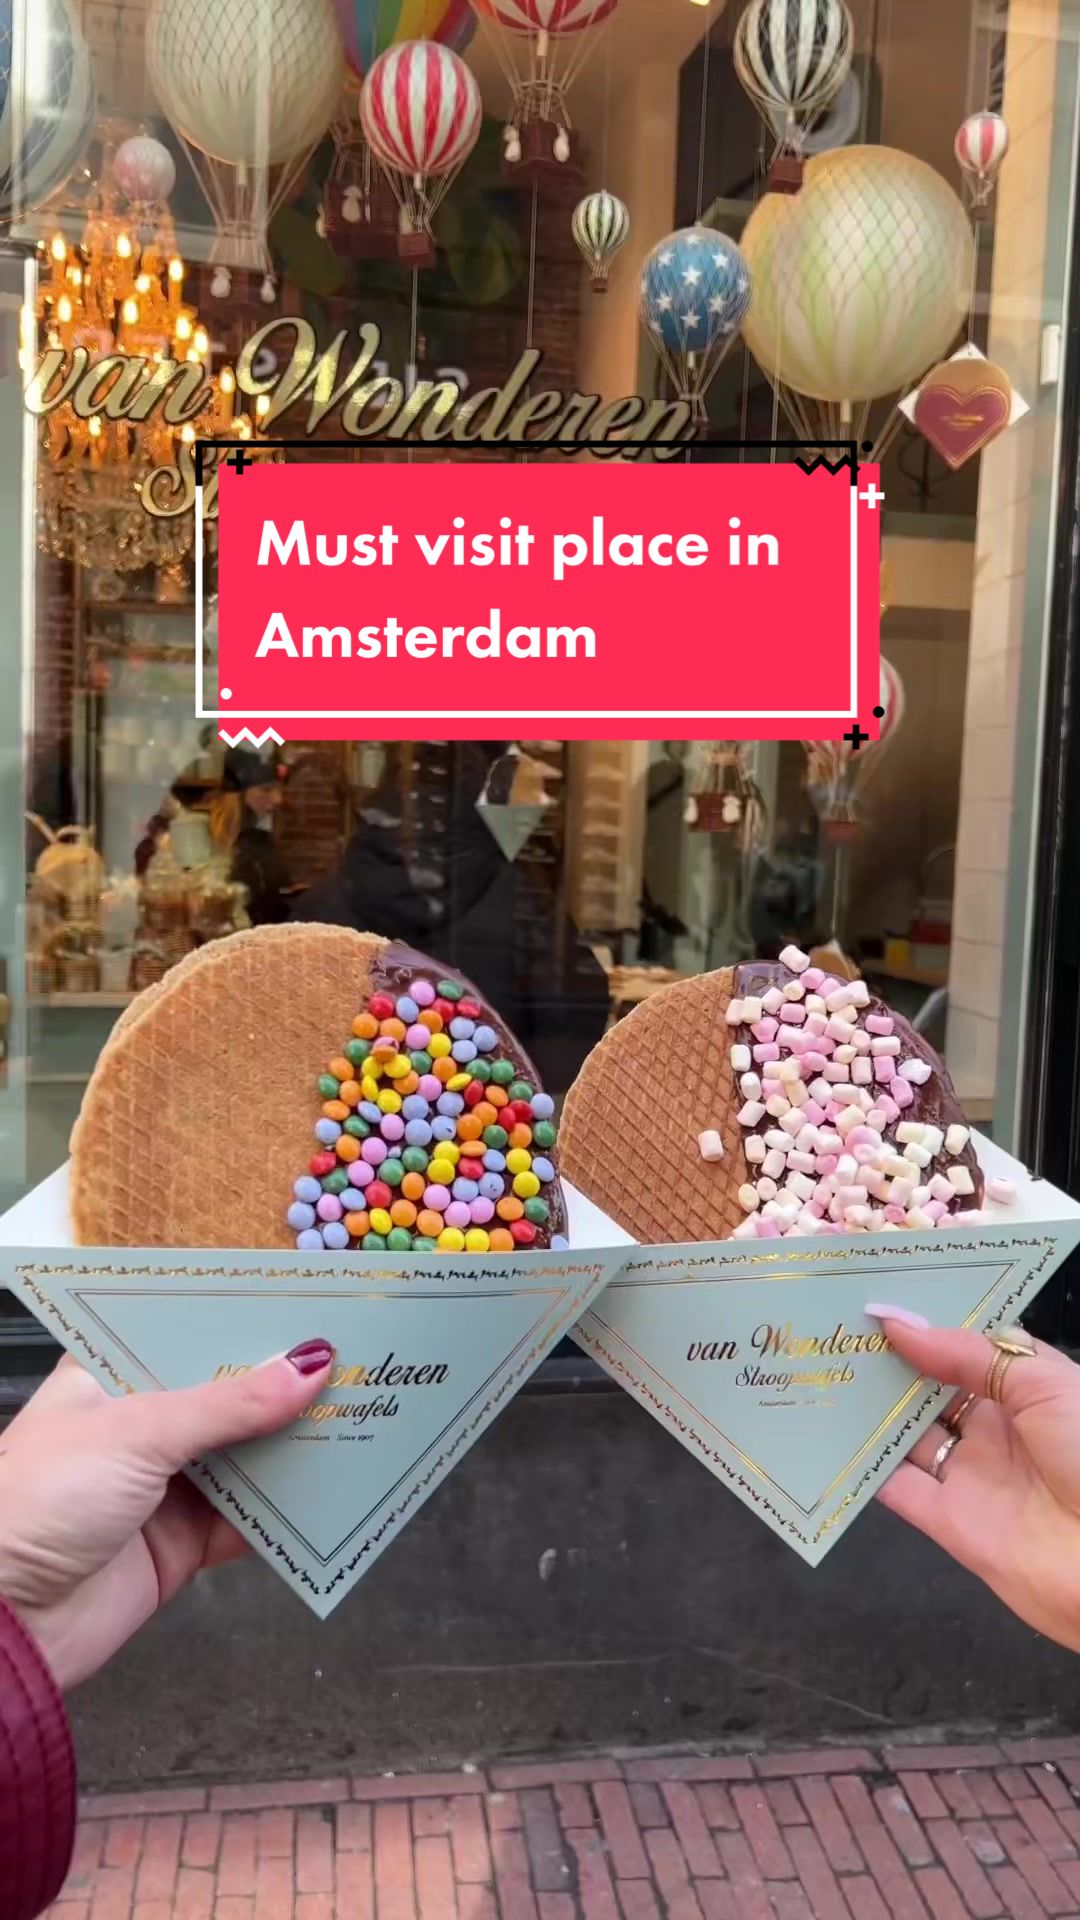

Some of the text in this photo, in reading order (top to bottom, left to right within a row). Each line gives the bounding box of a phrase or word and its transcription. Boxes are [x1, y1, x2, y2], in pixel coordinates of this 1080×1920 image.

[24, 346, 213, 425] van
[236, 316, 698, 460] Wonderen
[327, 1348, 450, 1387] onderen
[687, 1341, 739, 1361] van
